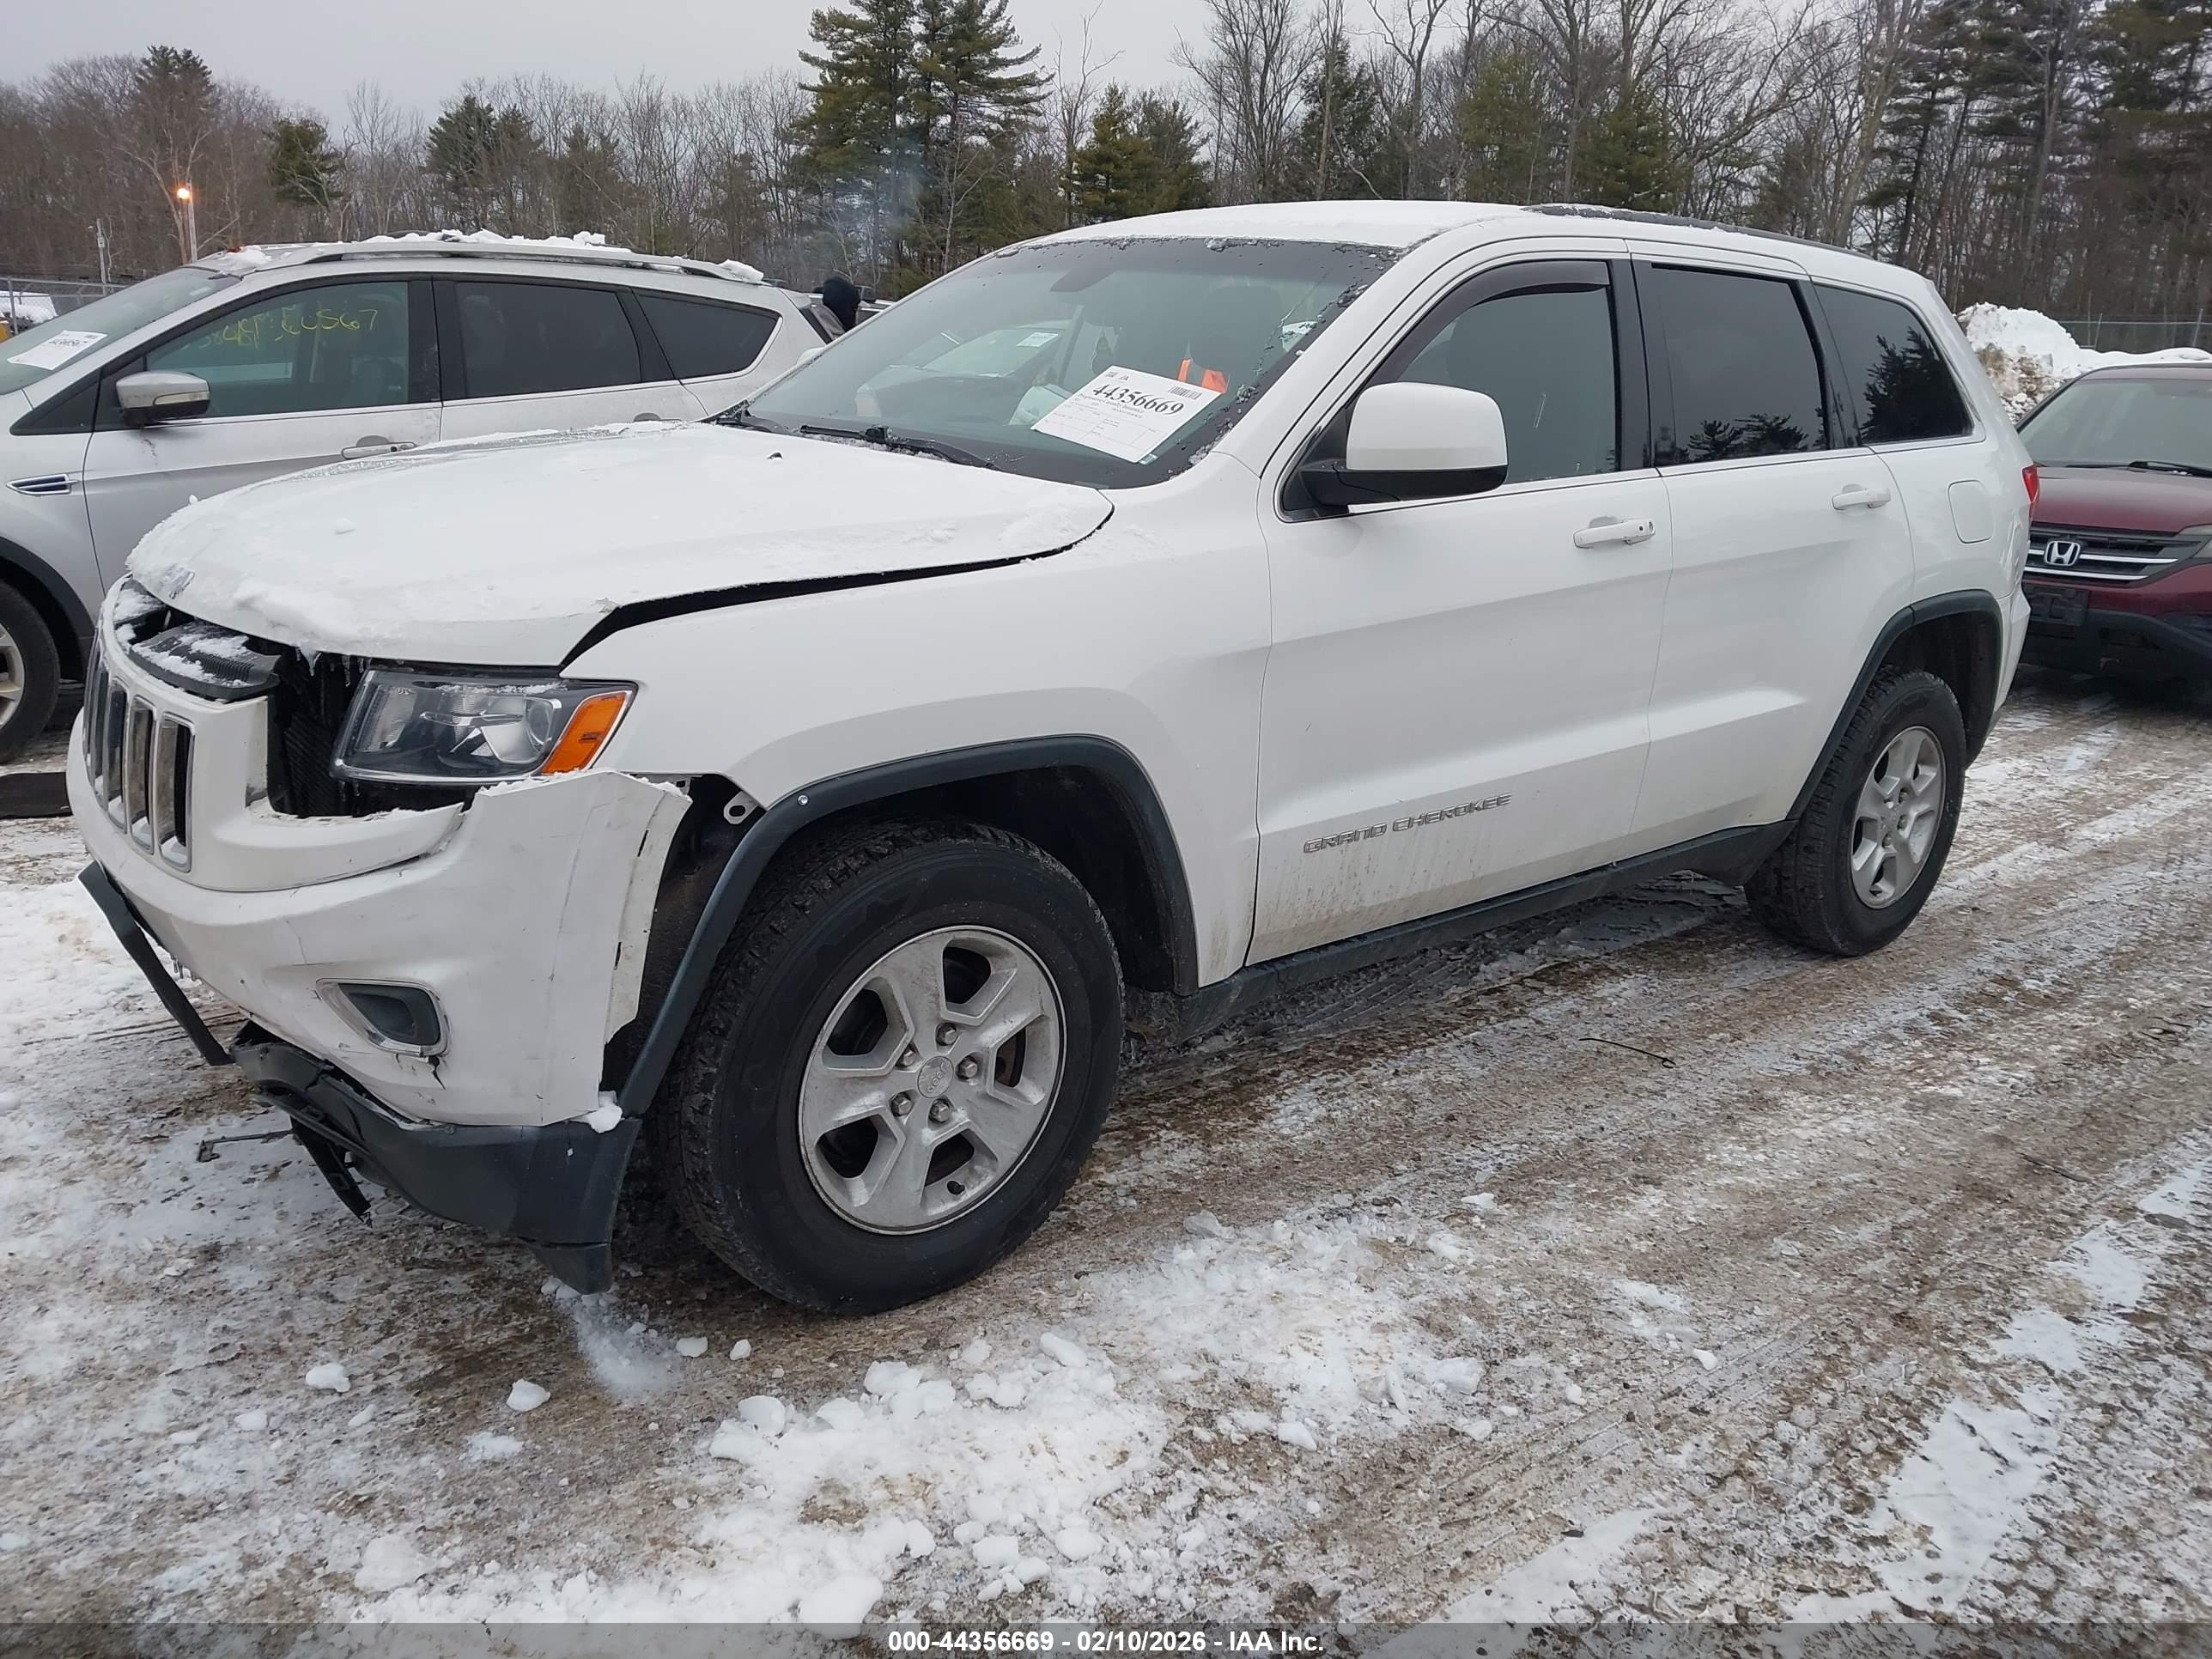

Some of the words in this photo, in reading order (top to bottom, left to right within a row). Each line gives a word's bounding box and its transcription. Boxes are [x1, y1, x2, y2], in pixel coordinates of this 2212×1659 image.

[1092, 383, 1184, 416] 44356669
[1303, 823, 1388, 853] GRAND
[1393, 792, 1512, 832] CHEROKEE
